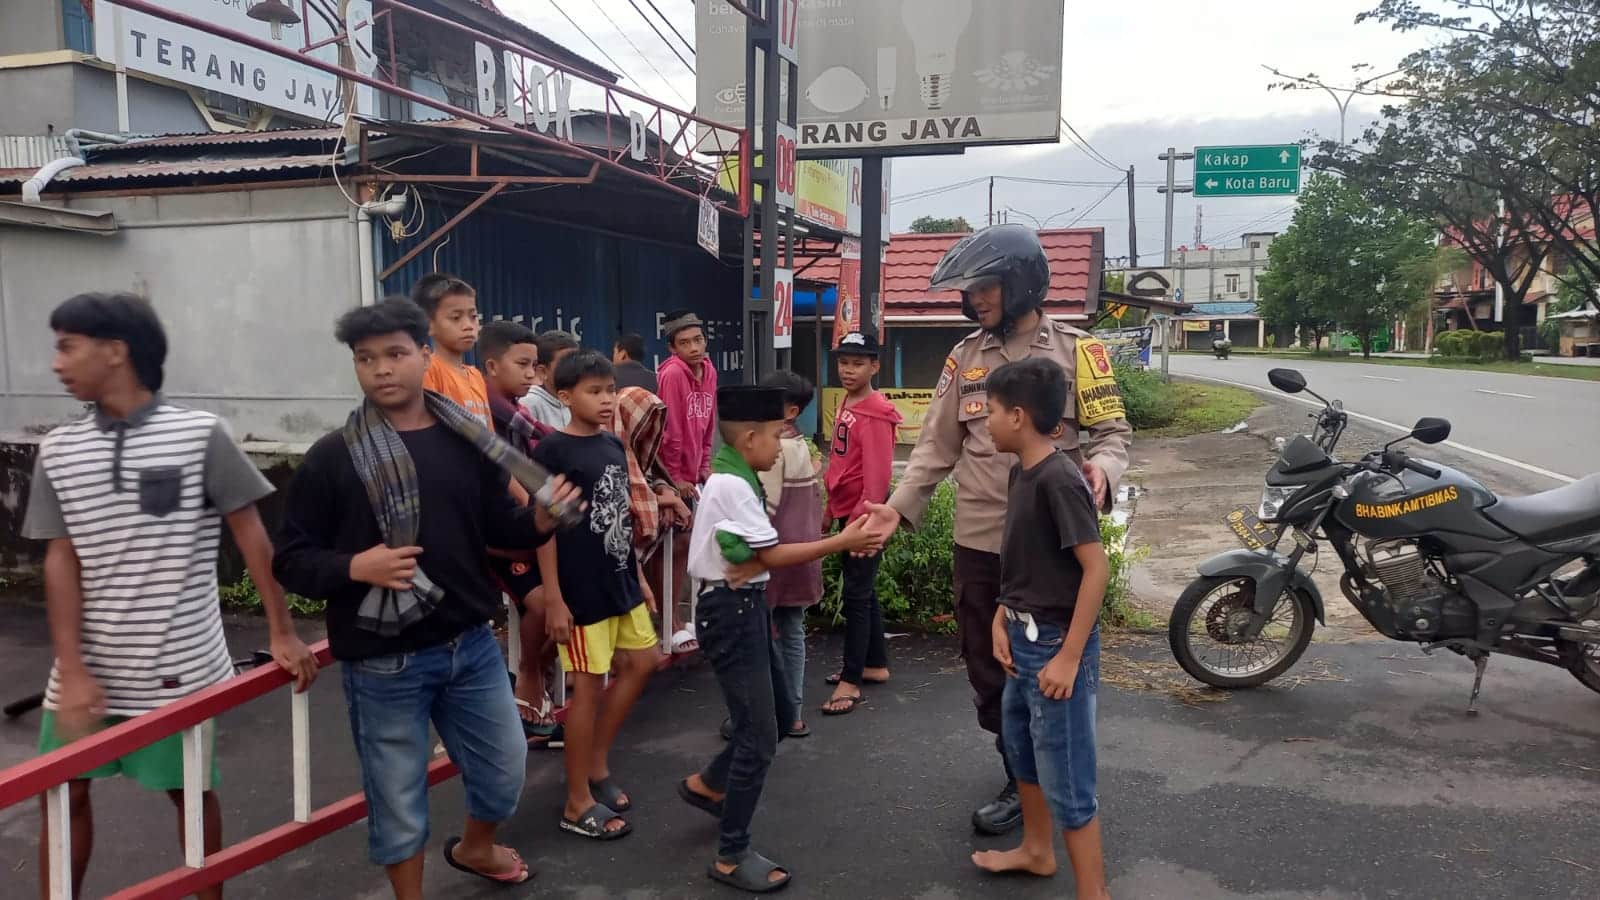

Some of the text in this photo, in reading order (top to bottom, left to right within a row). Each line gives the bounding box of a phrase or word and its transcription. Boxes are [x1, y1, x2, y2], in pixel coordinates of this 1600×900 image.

[130, 30, 266, 91] TERANG
[475, 40, 648, 161] BLOK D
[802, 117, 982, 144] RANG JAYA
[776, 134, 794, 196] 08
[1204, 153, 1249, 168] Kakap
[1225, 176, 1290, 189] Kota Baru
[775, 281, 791, 336] 24
[1355, 486, 1458, 518] BHABINKAMTIBMAS
